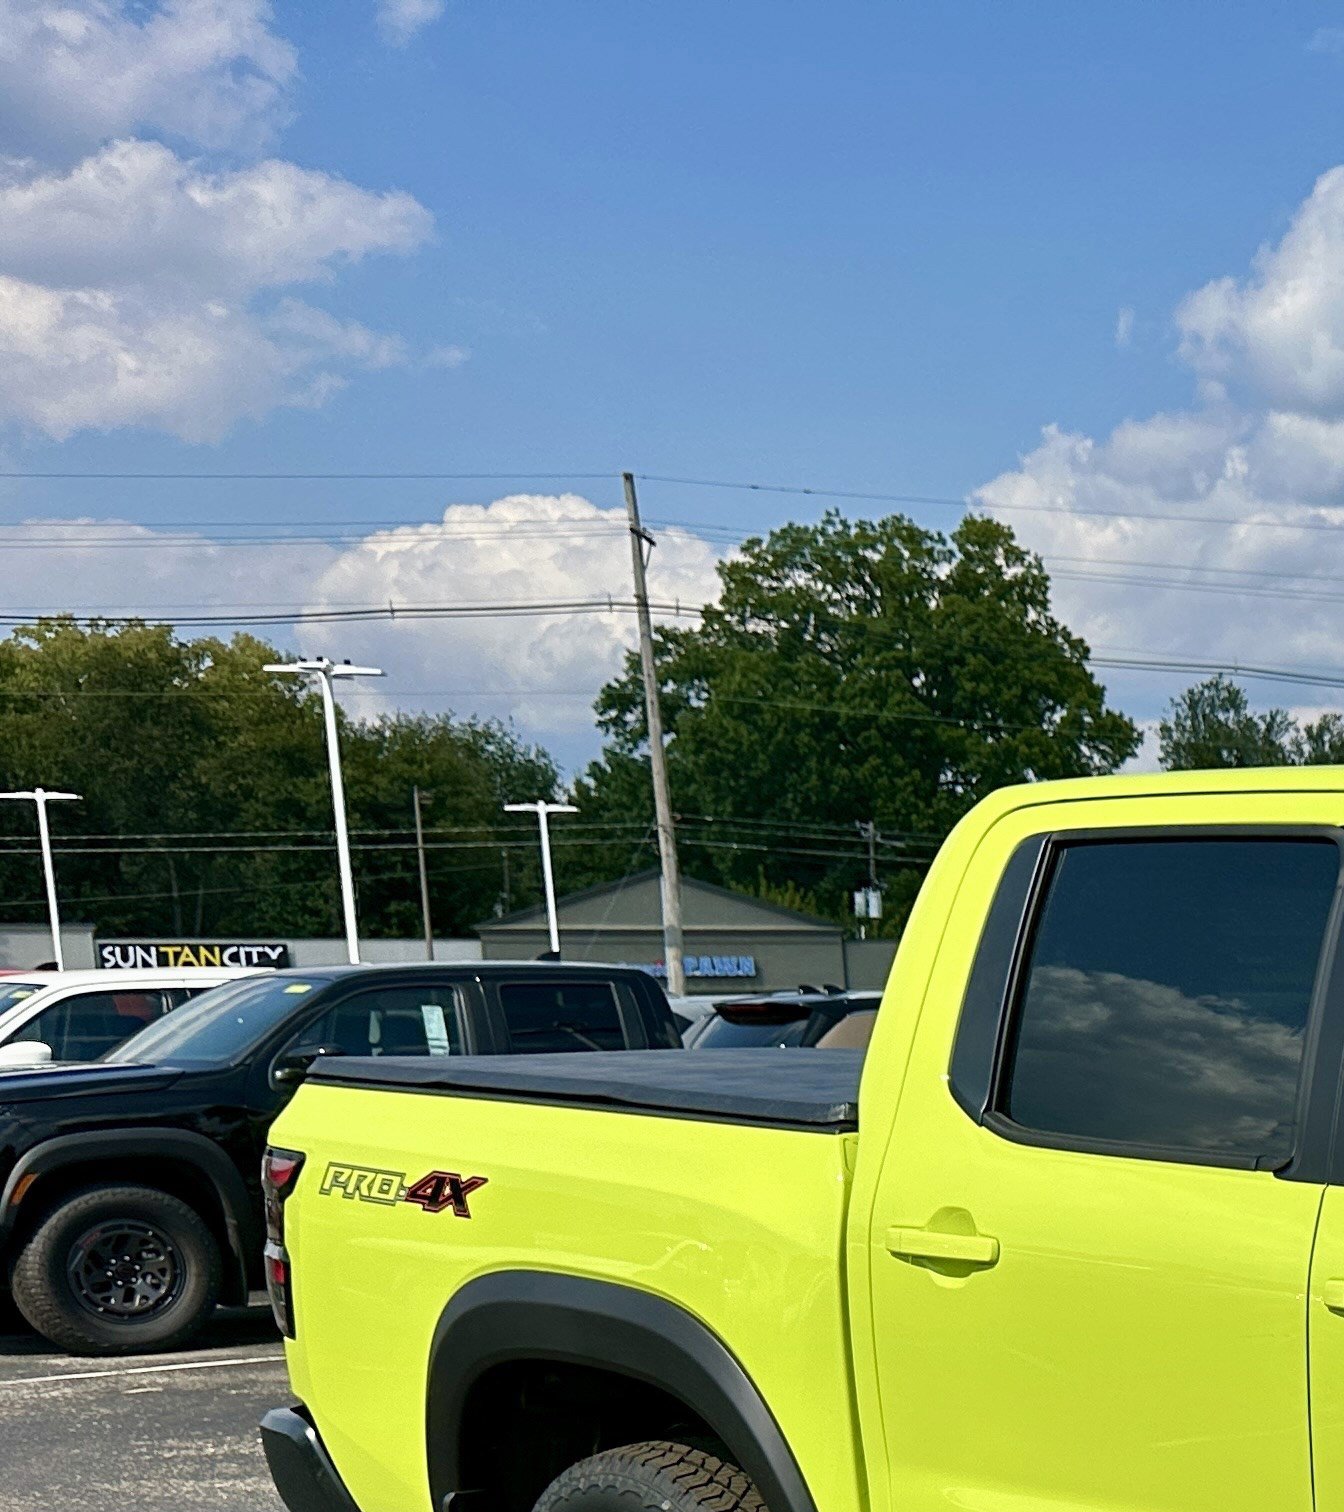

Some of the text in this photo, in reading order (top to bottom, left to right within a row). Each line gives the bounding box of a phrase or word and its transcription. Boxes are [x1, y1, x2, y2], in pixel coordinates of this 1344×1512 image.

[102, 945, 158, 968] SUN
[159, 945, 221, 967] TAN
[683, 956, 756, 977] PAWN
